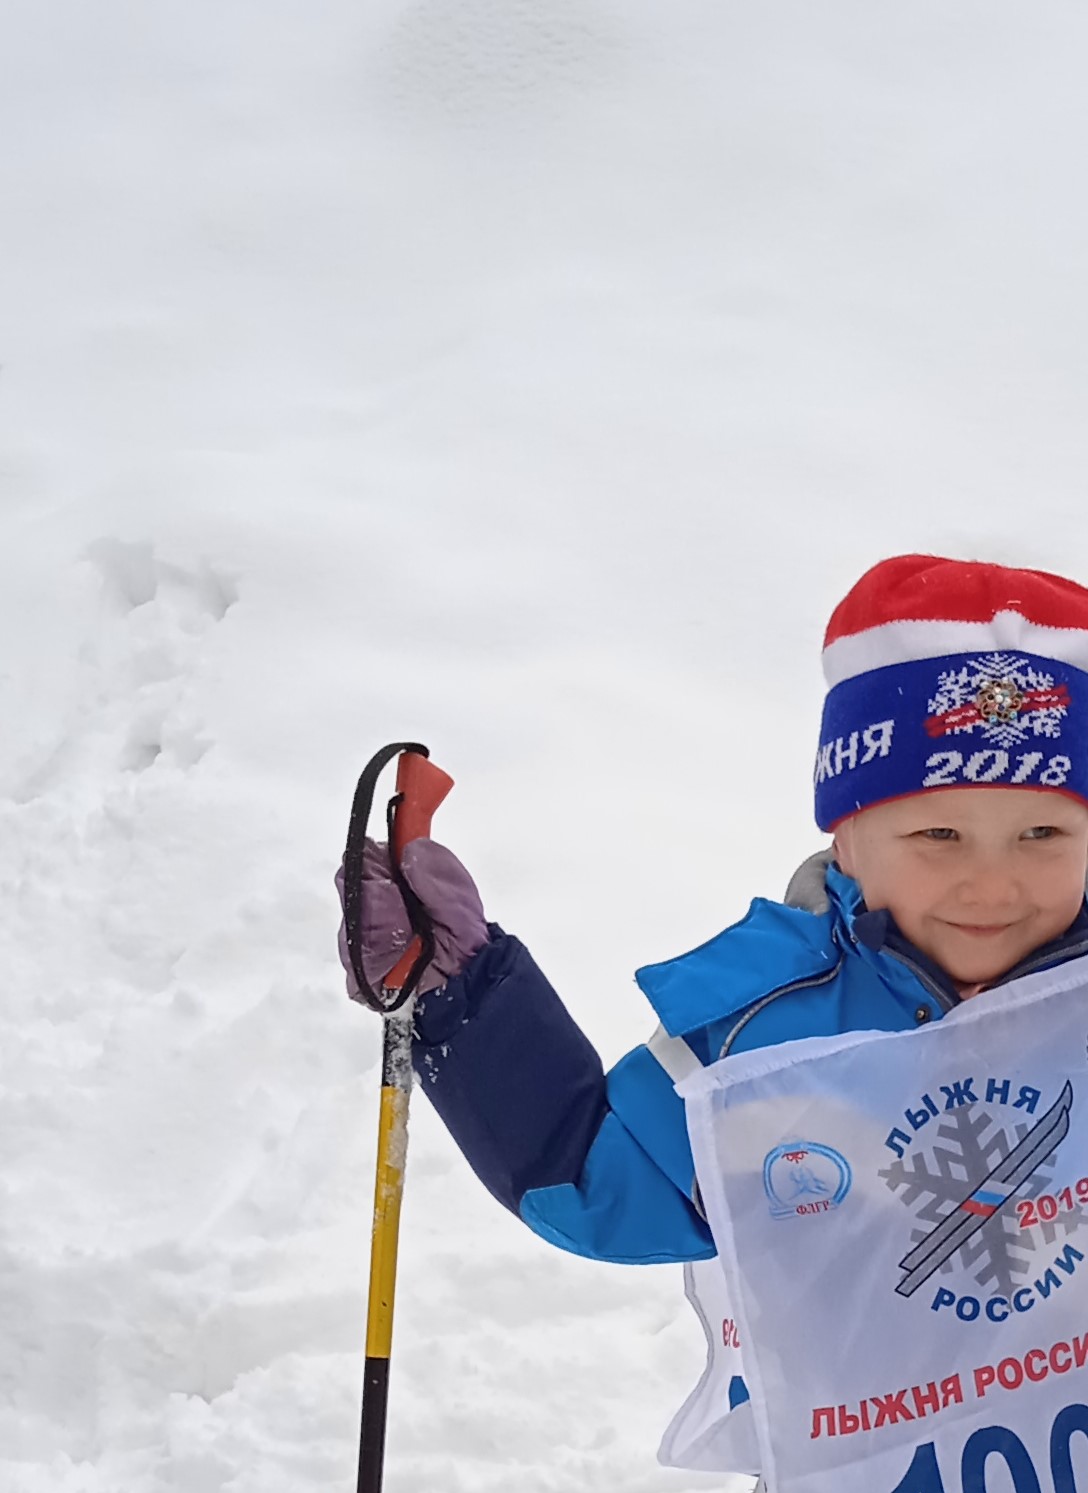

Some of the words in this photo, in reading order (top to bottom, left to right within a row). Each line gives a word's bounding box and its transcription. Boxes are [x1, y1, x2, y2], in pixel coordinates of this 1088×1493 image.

[922, 749, 1072, 787] 2018
[884, 1077, 1041, 1159] ЛЫЖНЯ
[931, 1243, 1084, 1322] РОССИИ
[810, 1374, 963, 1439] ЛЫЖНЯ
